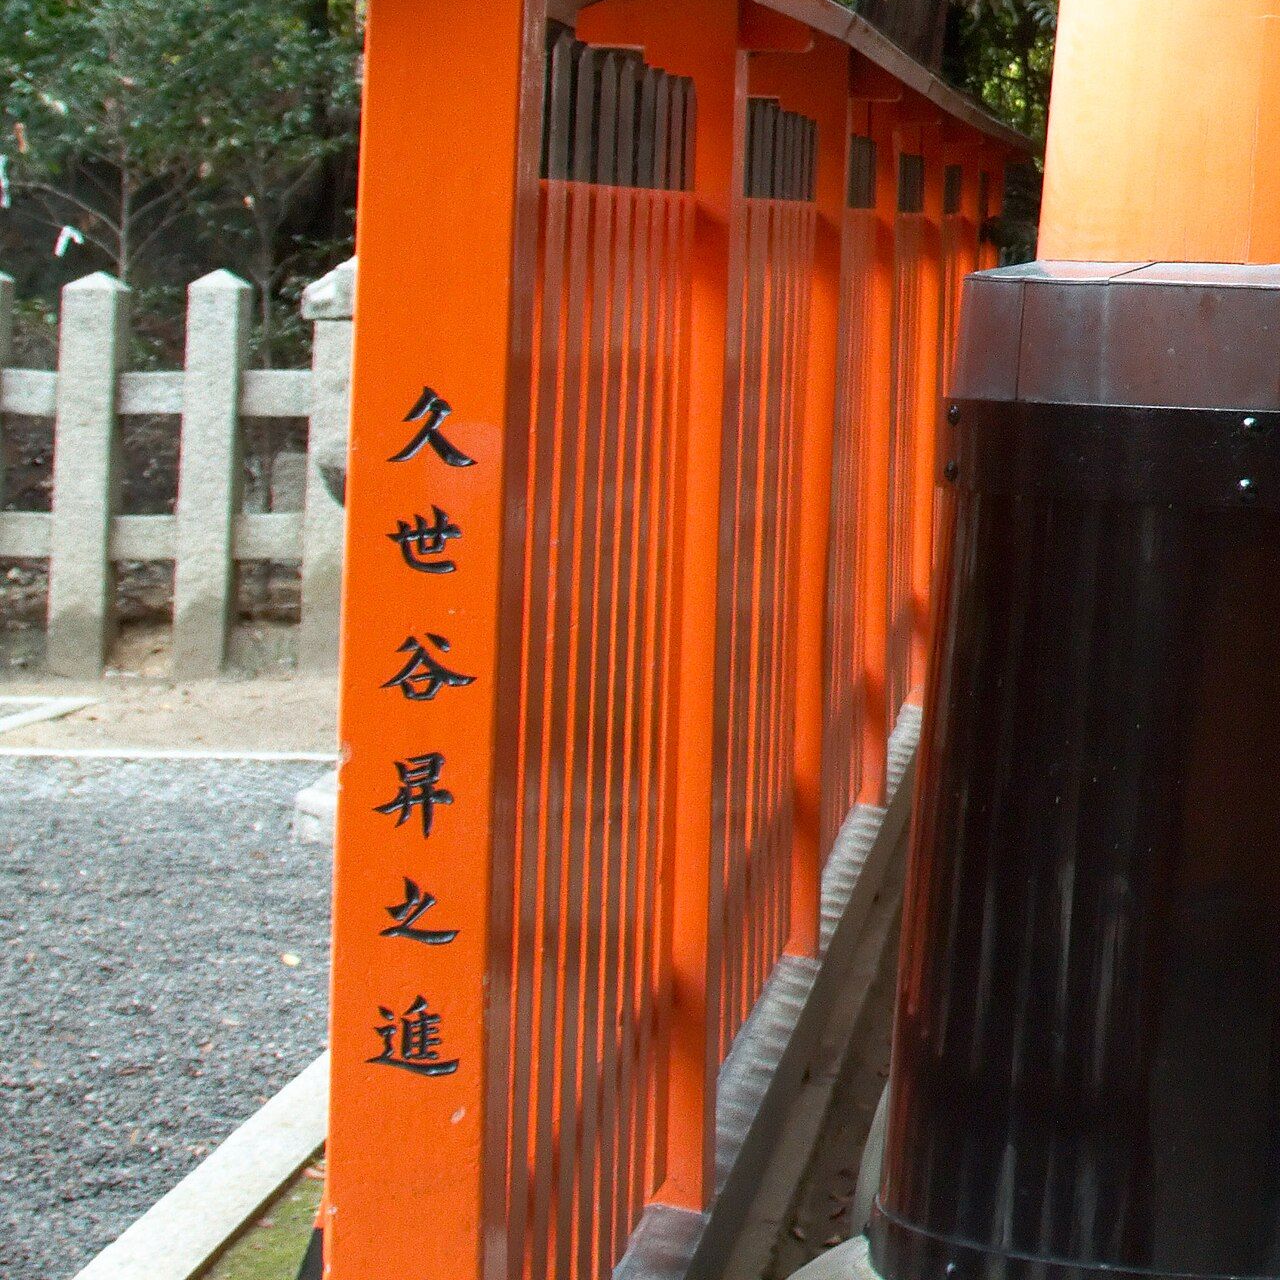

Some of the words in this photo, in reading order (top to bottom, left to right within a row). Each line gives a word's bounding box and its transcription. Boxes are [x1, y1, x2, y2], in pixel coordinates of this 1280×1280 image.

[365, 384, 479, 1078] 久世谷昇之進
